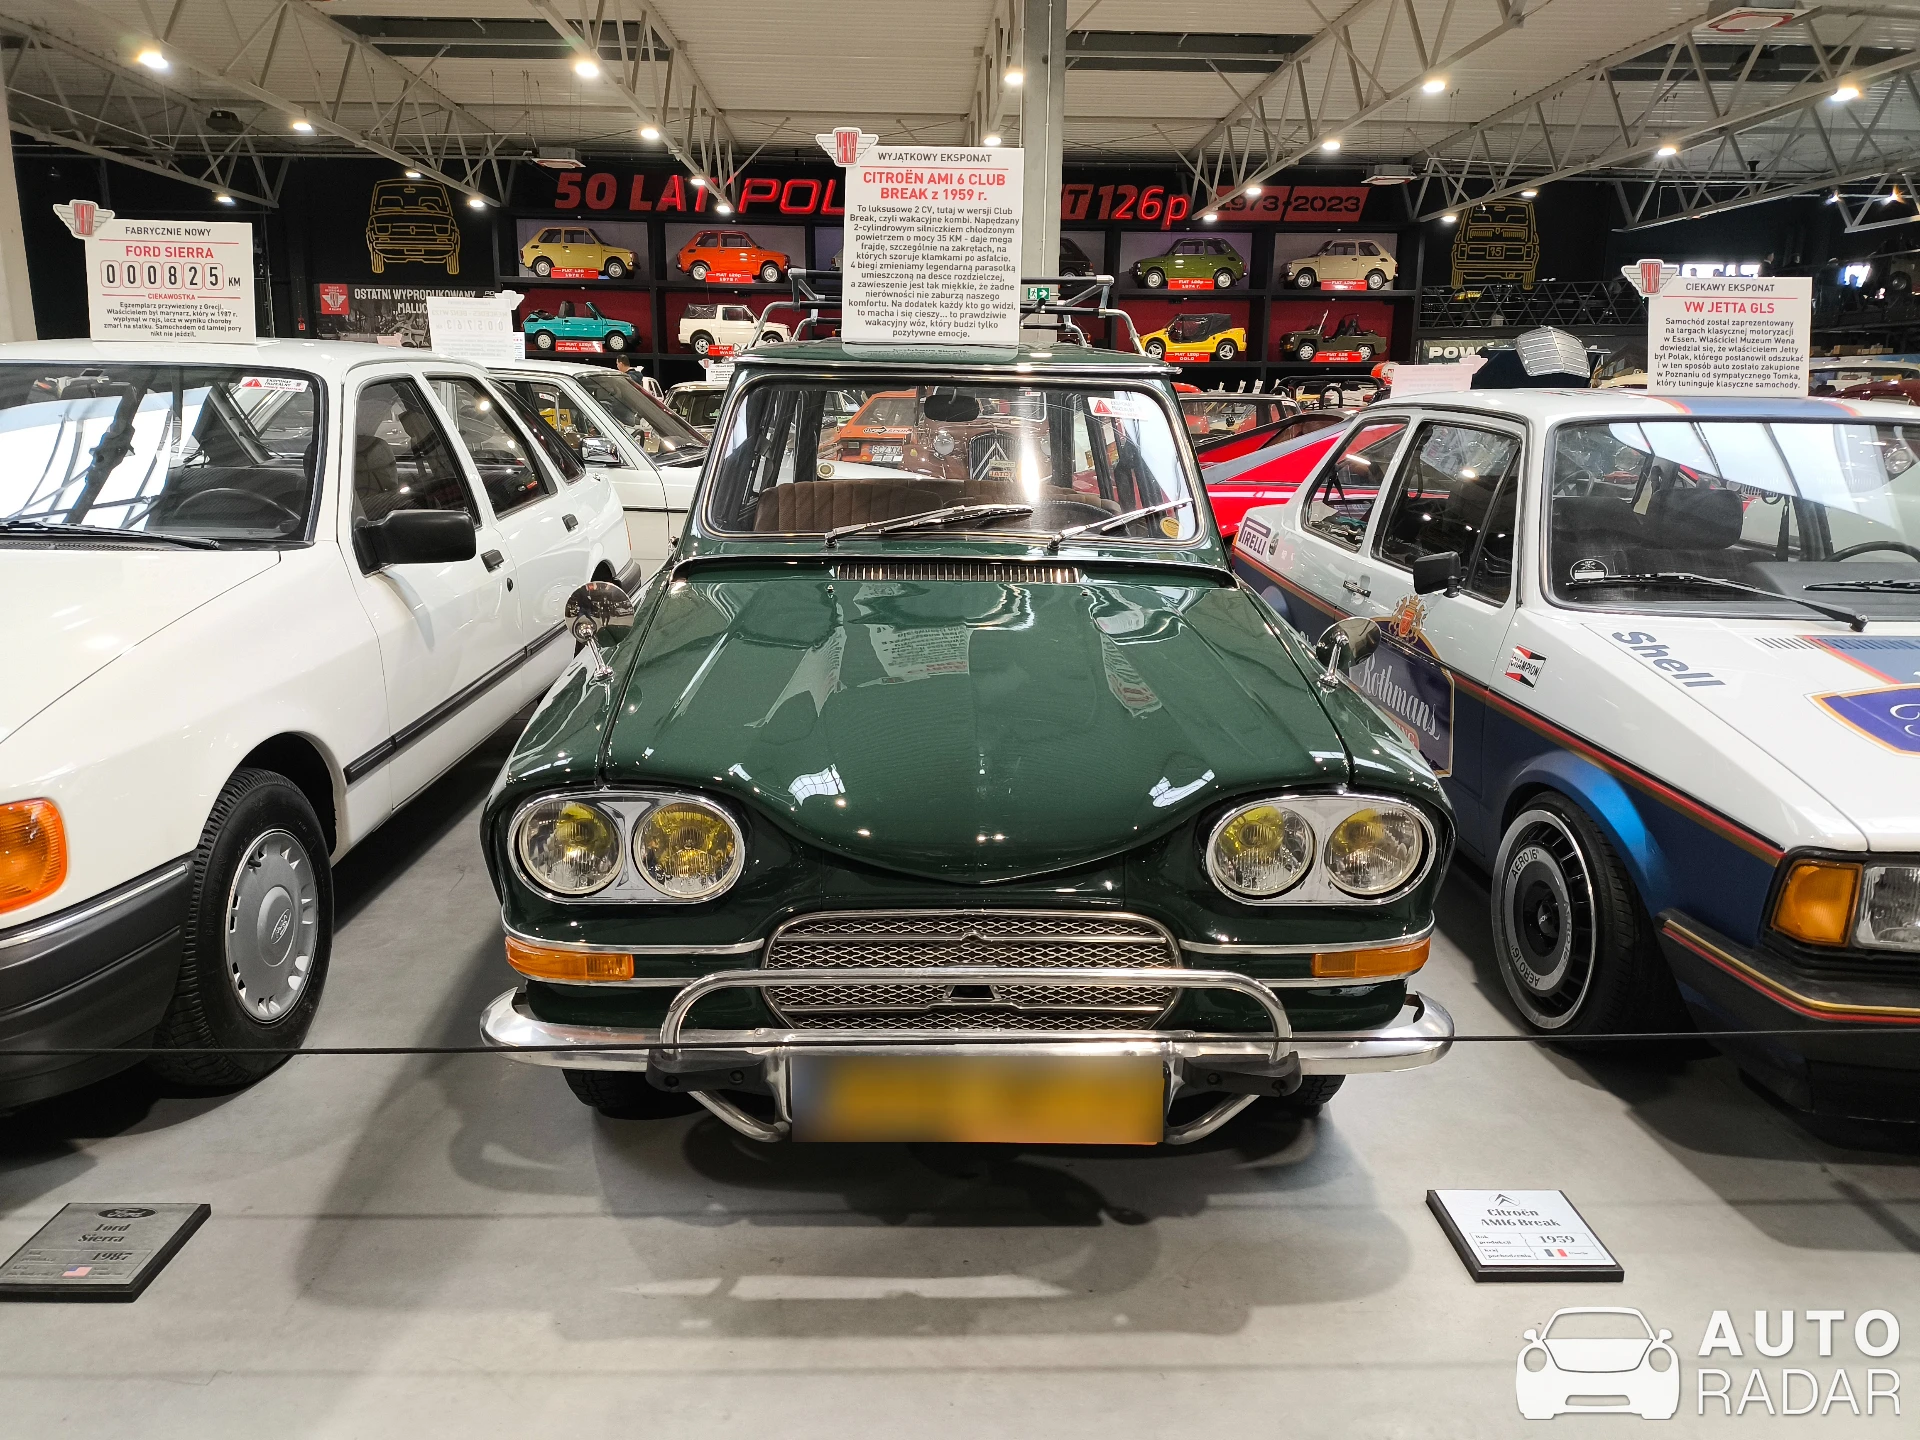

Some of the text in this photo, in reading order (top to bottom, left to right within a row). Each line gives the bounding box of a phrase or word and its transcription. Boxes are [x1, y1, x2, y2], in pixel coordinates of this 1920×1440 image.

[878, 152, 992, 163] WYJĄTKOWY EKSPONAT
[863, 169, 924, 184] CITROËN
[927, 173, 953, 185] AMI
[968, 173, 1006, 186] CLUB
[554, 172, 617, 211] 50
[880, 187, 928, 200] BREAK
[943, 188, 974, 201] 1959
[978, 192, 987, 201] r.
[857, 204, 866, 212] To
[868, 205, 912, 213] luksusowe
[922, 206, 934, 214] CV,
[937, 207, 956, 215] tutaj
[966, 206, 992, 216] wersji
[994, 207, 1012, 215] Club
[1098, 185, 1192, 230] 126p
[850, 214, 1020, 226] Break, czyli wakacyjne kombi. Napędzany
[125, 226, 211, 236] FABRYCZNIE NOWY
[854, 223, 1014, 235] 2-cylindrowym silniczkiem chłodzonym
[856, 233, 904, 242] powietrzem
[937, 234, 946, 242] 35
[970, 235, 988, 244] daje
[990, 234, 1012, 245] mega
[126, 245, 214, 258] FORD SIERRA
[861, 242, 888, 252] frajdę,
[890, 242, 938, 253] szczególnie
[952, 244, 994, 254] zakrętach,
[856, 251, 1010, 263] których szoruje klamkami po asfalcie.
[858, 261, 878, 270] biegi
[879, 261, 924, 272] zmieniamy
[926, 263, 972, 272] legendarną
[974, 264, 1016, 273] parasolką
[228, 277, 241, 287] KM
[861, 270, 914, 281] umieszczoną
[928, 272, 952, 280] desce
[954, 272, 1004, 282] rozdzielczej,
[1686, 283, 1775, 292] CIEKAWY EKSPONAT
[354, 288, 391, 300] OSTATNI
[866, 289, 914, 298] nierówności
[931, 290, 964, 300] zaburzą
[966, 293, 1000, 301] naszego
[1684, 301, 1774, 314] VW JETTA GLS
[868, 309, 894, 317] macha
[900, 310, 912, 319] się
[914, 310, 948, 320] cieszy...
[960, 311, 1006, 320] prawdziwie
[864, 318, 998, 330] wakacyjny wóz, który budzi tylko
[1666, 317, 1794, 328] Samochód został zaprezentowany
[892, 329, 970, 339] pozytywne emocje.
[1676, 327, 1706, 335] targach
[1708, 328, 1747, 336] klasycznej
[1750, 327, 1794, 337] motoryzacji
[1740, 336, 1772, 344] Muzeum
[1429, 346, 1482, 359] POW
[1660, 344, 1700, 352] dowiedział
[1728, 345, 1778, 353] właścicielem
[1780, 346, 1798, 354] Jetty
[1654, 353, 1666, 361] był
[1694, 353, 1723, 362] którego
[1725, 354, 1766, 363] postanowił
[1768, 354, 1804, 362] odszukać
[1684, 361, 1712, 371] sposób
[1760, 363, 1800, 372] zakupione
[1665, 370, 1700, 378] Poznaniu
[1712, 372, 1771, 380] sympatycznego
[1656, 379, 1676, 388] który
[1678, 380, 1714, 388] tuninguje
[1716, 380, 1754, 389] klasyczne
[1238, 516, 1271, 556] PIRELLI
[1611, 630, 1727, 688] Shell
[1510, 655, 1540, 678] CHAMPION
[1358, 652, 1441, 741] Rothmans
[1487, 1207, 1539, 1217] Citroën
[94, 1223, 131, 1232] Ford
[1517, 1219, 1561, 1227] Break
[77, 1234, 125, 1243] Sierra
[1539, 1235, 1576, 1244] 1959
[91, 1252, 133, 1261] 1987
